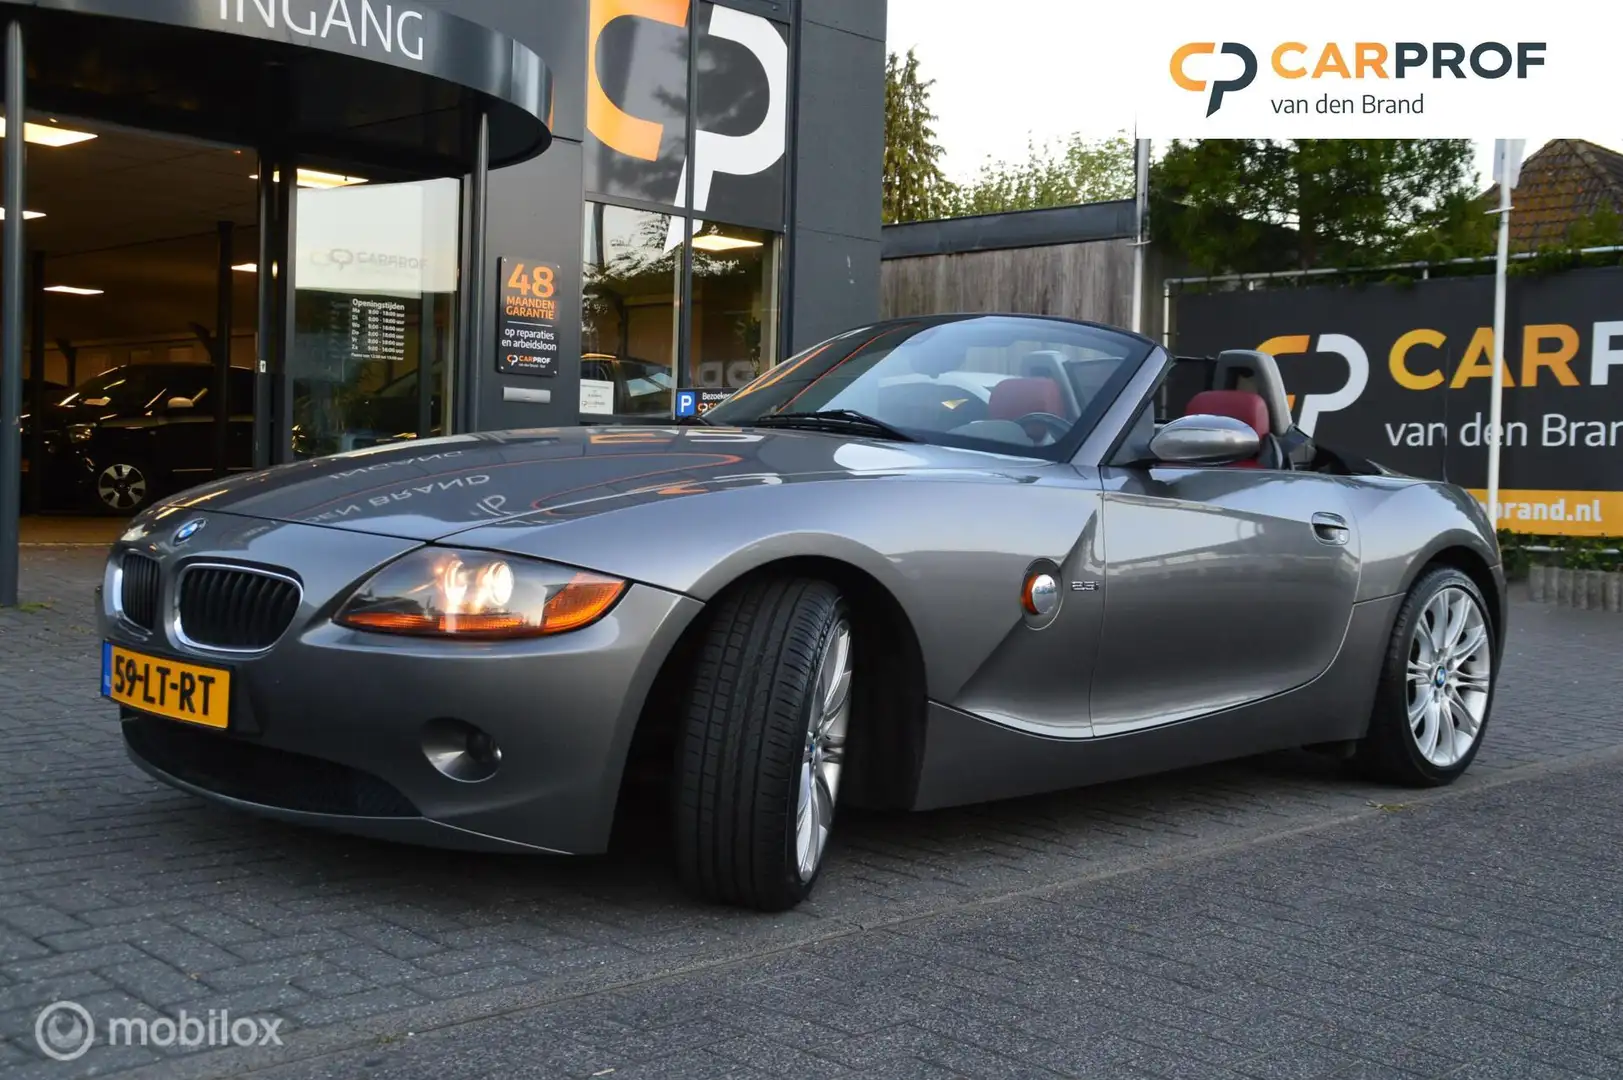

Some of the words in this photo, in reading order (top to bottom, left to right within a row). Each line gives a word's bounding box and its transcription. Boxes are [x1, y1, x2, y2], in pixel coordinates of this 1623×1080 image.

[508, 263, 555, 298] 48
[352, 298, 405, 311] Openingstijden
[506, 296, 555, 310] MAANDEN
[506, 305, 555, 320] GARANTIE
[505, 328, 515, 338] op
[516, 329, 555, 340] reparaties
[502, 339, 512, 347] en
[513, 339, 557, 351] arbeidsloon
[519, 355, 552, 364] CARPROF
[1385, 421, 1448, 447] van
[1460, 412, 1528, 447] den
[115, 654, 215, 716] 59-LT-RT
